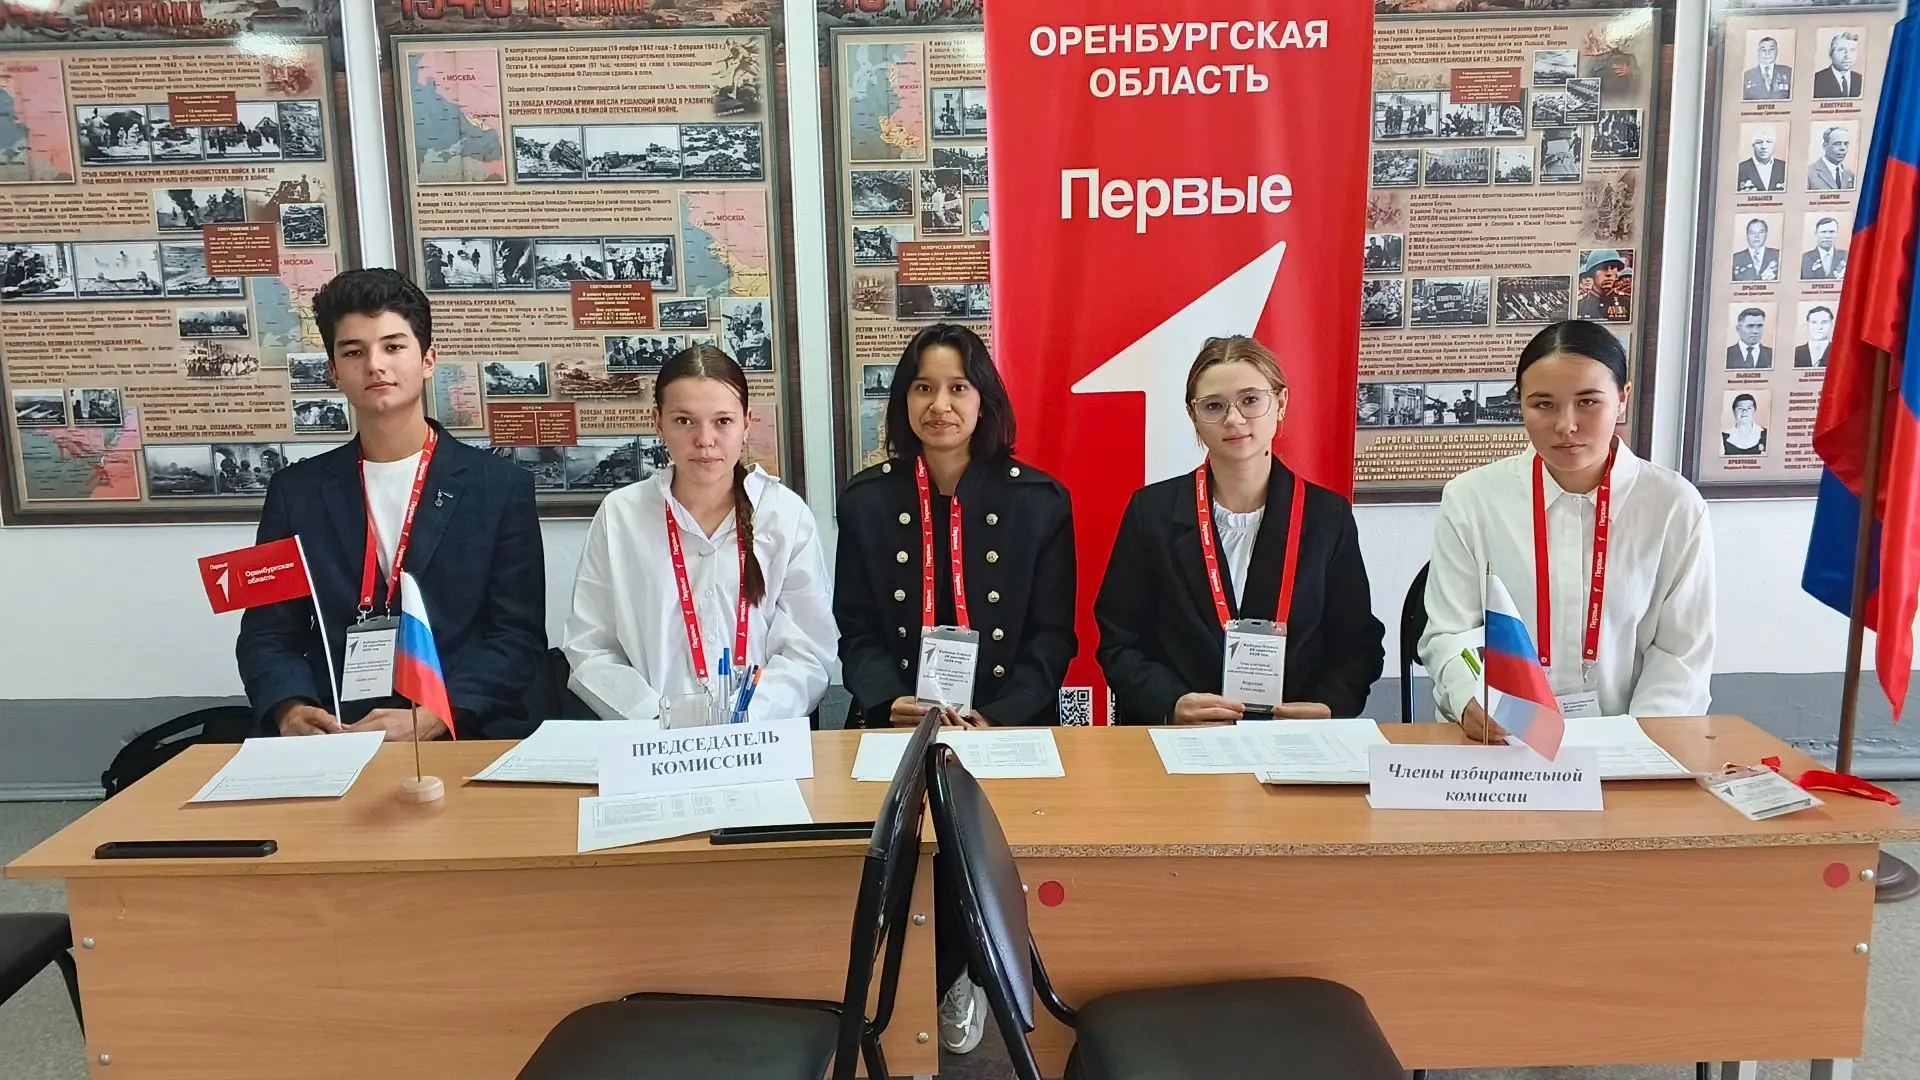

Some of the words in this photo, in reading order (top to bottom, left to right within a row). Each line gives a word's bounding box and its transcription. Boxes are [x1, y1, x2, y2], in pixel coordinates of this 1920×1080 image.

[1029, 19, 1329, 56] ОРЕНБУРГСКАЯ
[1089, 64, 1269, 98] ОБЛАСТЬ
[1061, 168, 1293, 233] Первые
[1442, 435, 1490, 444] ДОСТАЛАСЬ
[407, 501, 418, 524] Первые
[1599, 500, 1607, 527] Первые
[669, 532, 680, 555] Первые
[951, 526, 959, 550] Первые
[1201, 521, 1210, 546] Первые
[396, 545, 406, 568] Первые
[925, 543, 933, 567] Первые
[1595, 551, 1603, 578] Первые
[245, 562, 294, 577] Оренбургская
[247, 574, 276, 585] область
[1210, 568, 1220, 593] Первые
[680, 577, 689, 601] Первые
[1590, 602, 1599, 629] Первые
[689, 624, 700, 649] Первые
[632, 730, 780, 757] ПРЕДСЕДАТЕЛЬ
[651, 752, 763, 776] КОМИССИИ
[1388, 763, 1444, 780] Члены
[1450, 765, 1583, 785] избирательной
[1445, 790, 1528, 803] комиссии
